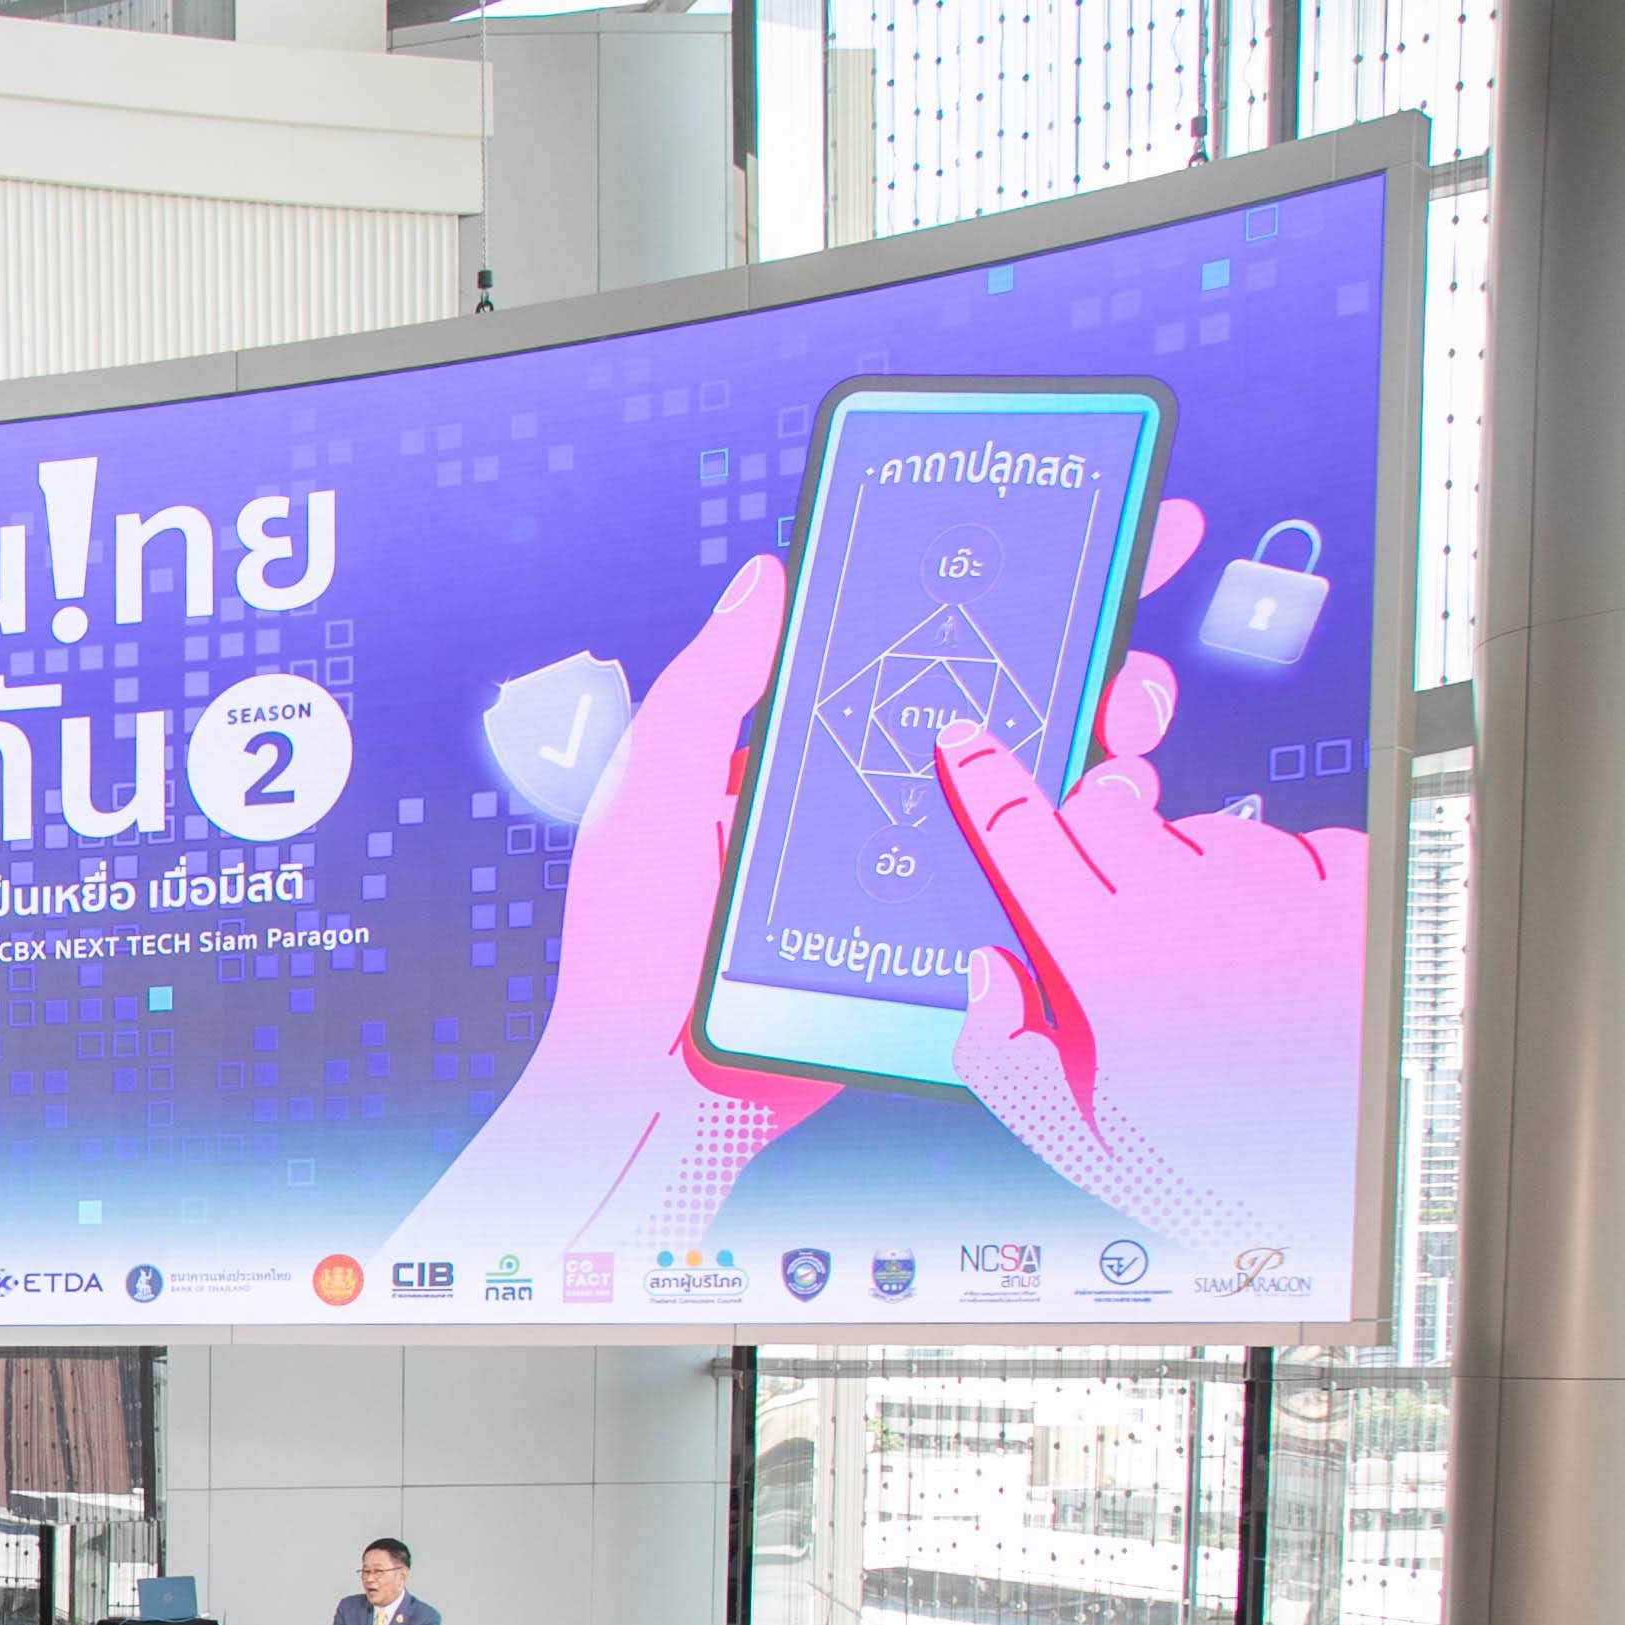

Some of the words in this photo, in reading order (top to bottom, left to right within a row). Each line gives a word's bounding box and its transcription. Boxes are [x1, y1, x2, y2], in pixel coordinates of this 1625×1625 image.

[878, 441, 1086, 498] คาถาปลุกสติ
[226, 702, 313, 725] SEASON
[243, 731, 296, 806] 2
[149, 856, 306, 909] เมื่อมีสติ
[54, 936, 118, 960] NEXT
[126, 933, 193, 957] TECH
[199, 928, 258, 952] Siam
[266, 924, 370, 954] Paragon
[960, 1244, 1041, 1273] NCSA
[23, 1272, 104, 1294] ETDA
[392, 1262, 454, 1288] CIB
[565, 1273, 611, 1288] FACT
[649, 1274, 742, 1292] สภาผู้บริโภค
